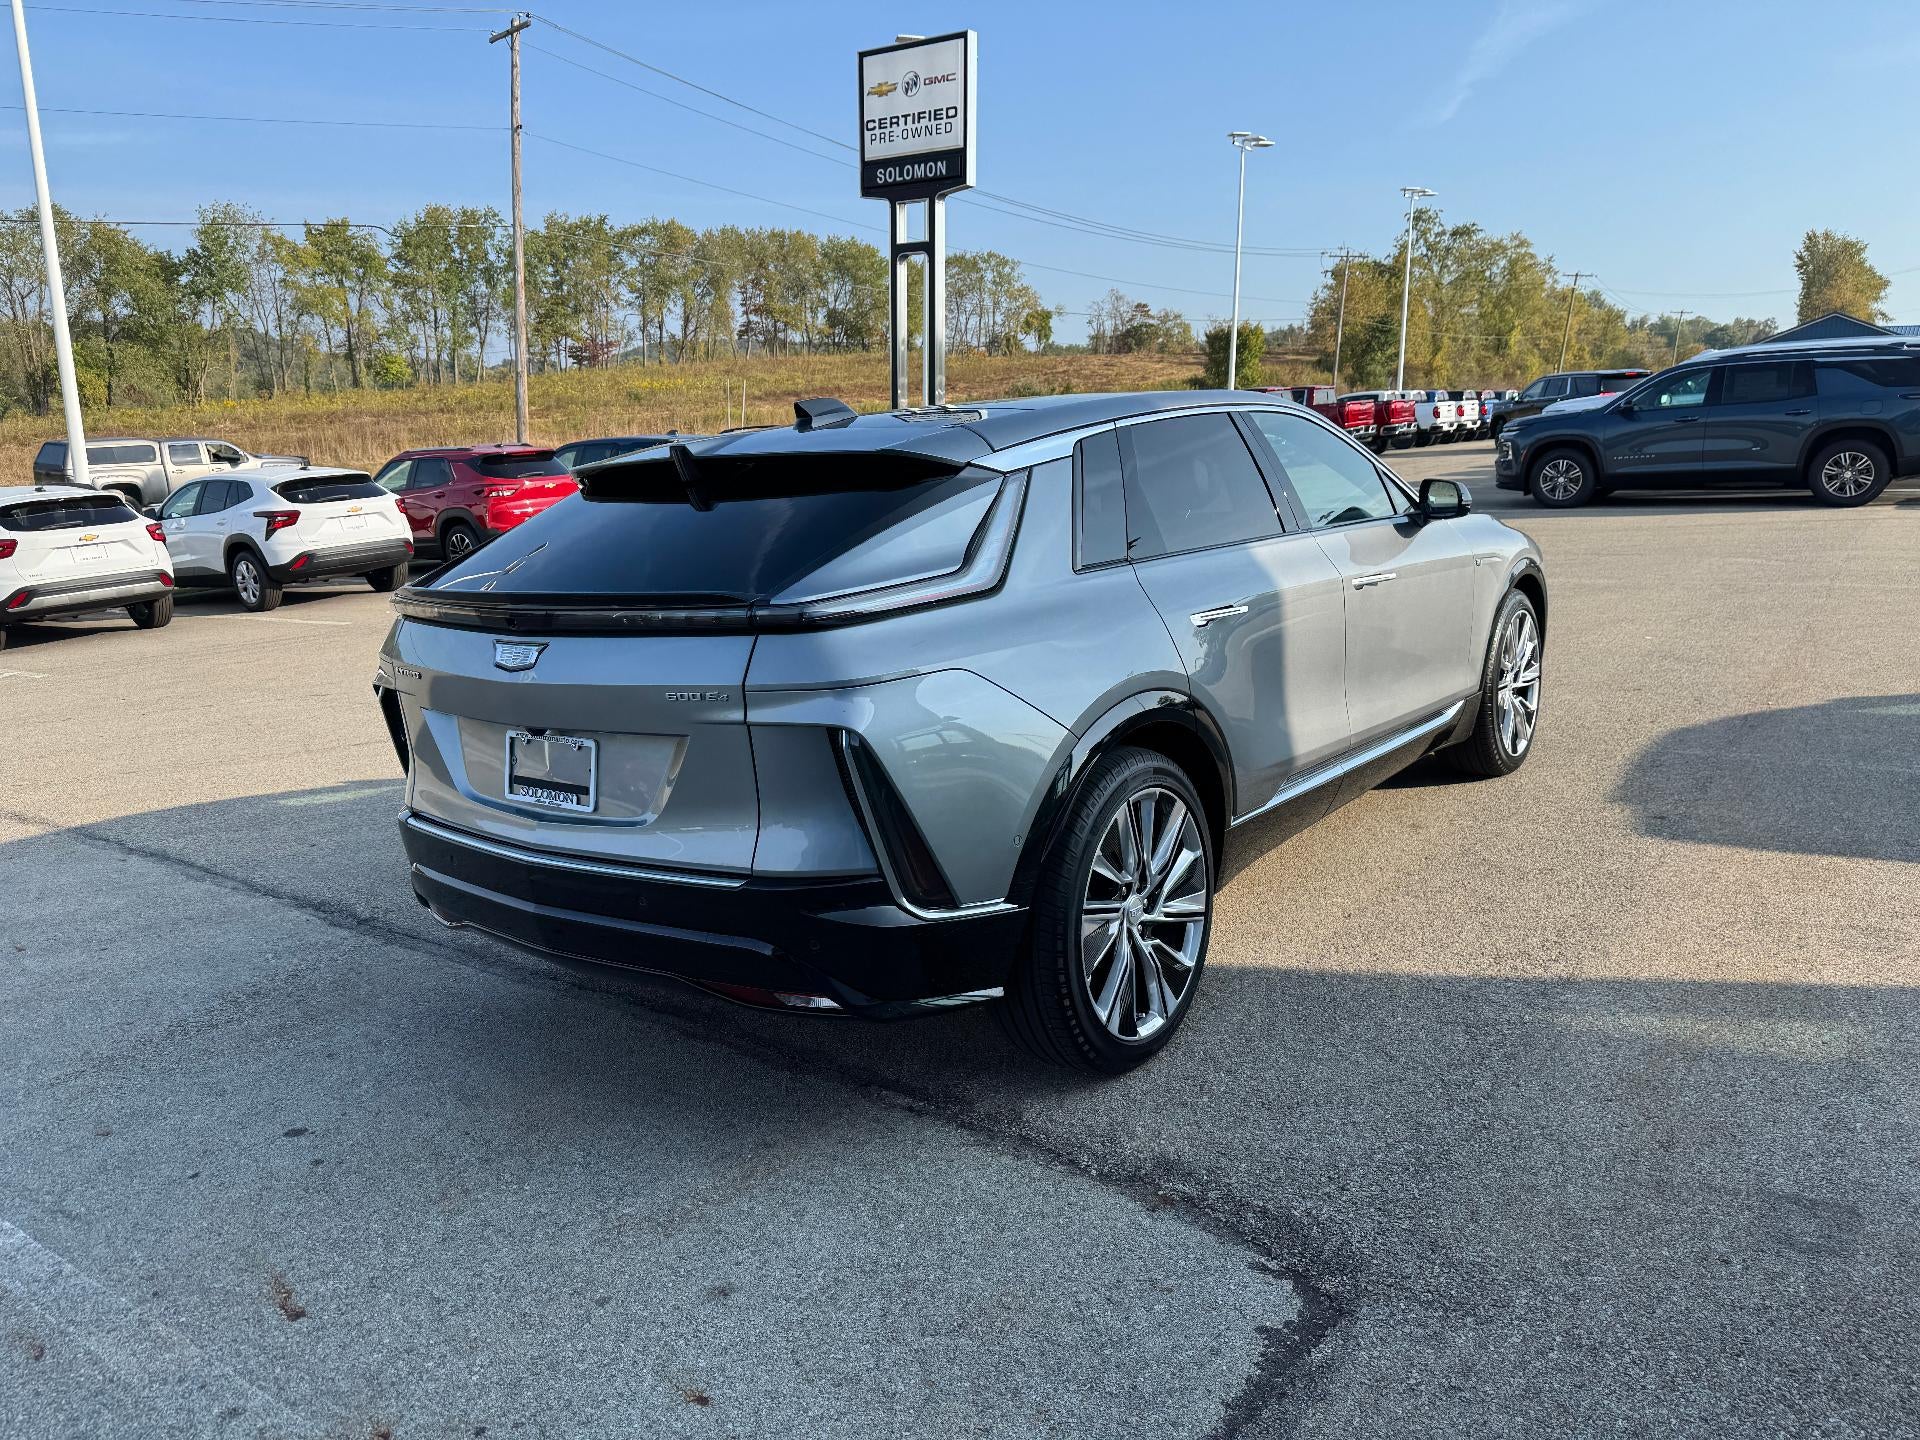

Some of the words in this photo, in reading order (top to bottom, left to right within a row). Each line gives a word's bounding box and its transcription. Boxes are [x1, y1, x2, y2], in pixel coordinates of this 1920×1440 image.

[924, 73, 957, 86] GMC
[865, 106, 958, 132] CERTIFIED
[870, 122, 953, 146] PRE-OWNED
[876, 160, 946, 184] SOLOMON
[520, 786, 574, 805] SOLOMON
